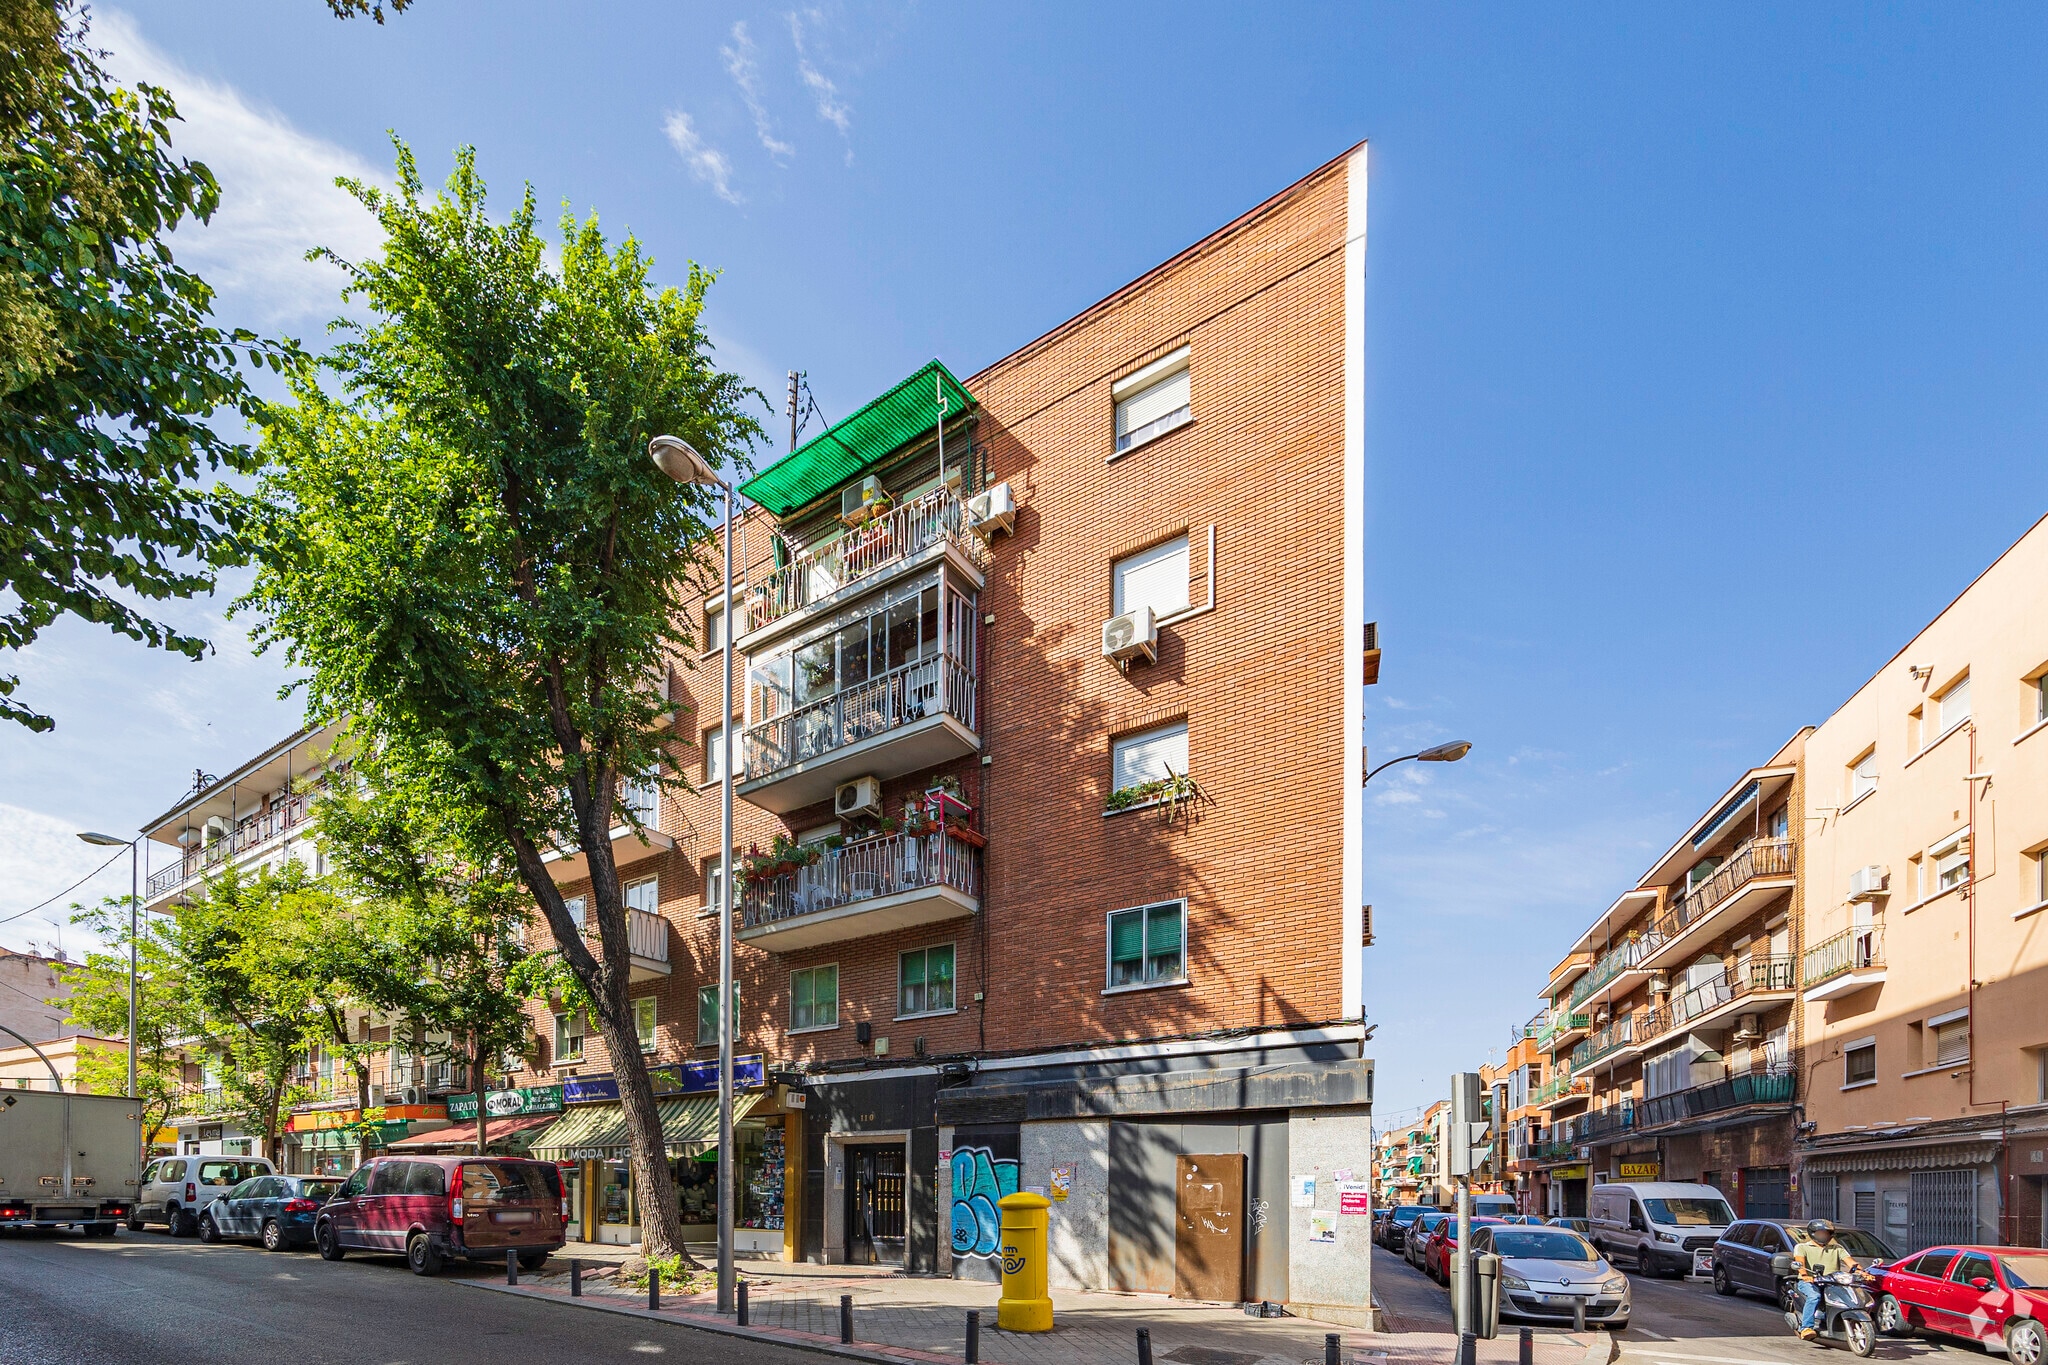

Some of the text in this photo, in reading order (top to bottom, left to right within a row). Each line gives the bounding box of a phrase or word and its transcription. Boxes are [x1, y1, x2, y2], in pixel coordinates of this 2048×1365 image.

[449, 1100, 479, 1112] ZAPATO
[496, 1096, 521, 1109] MORAL
[525, 1102, 558, 1112] CABALLERO
[860, 1113, 874, 1122] 110
[570, 1149, 605, 1160] MODA
[1622, 1164, 1658, 1175] BAZAR
